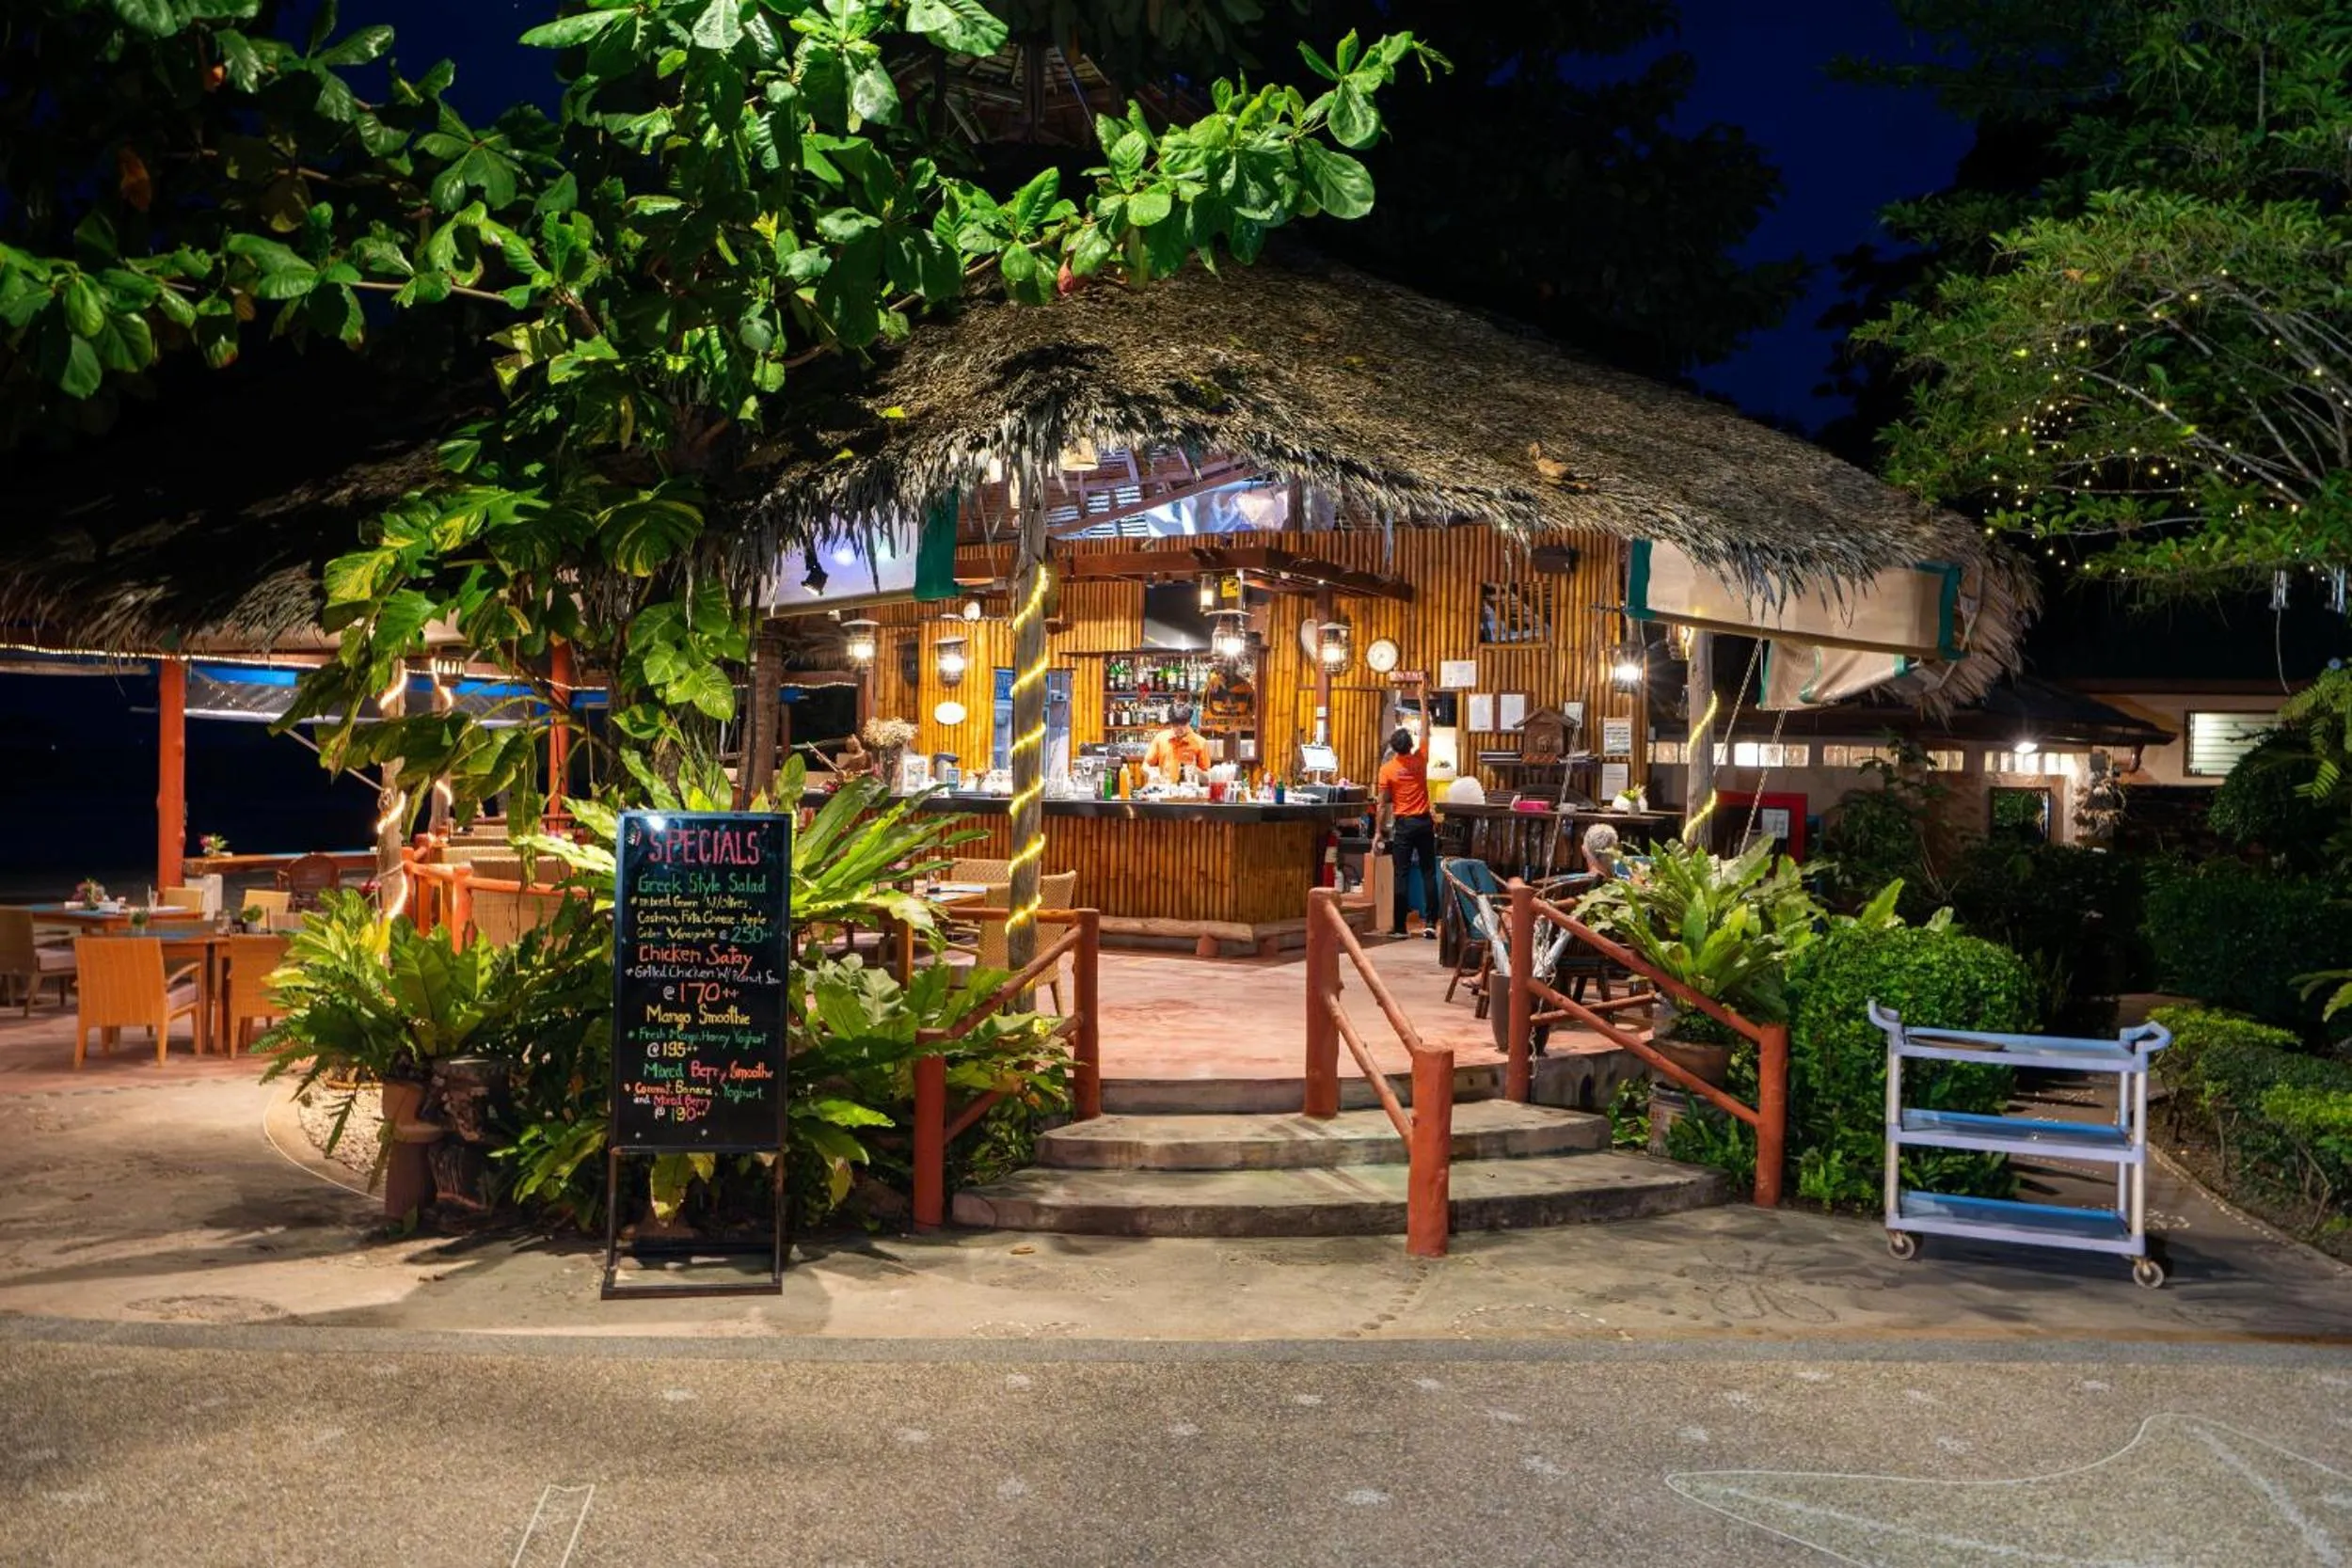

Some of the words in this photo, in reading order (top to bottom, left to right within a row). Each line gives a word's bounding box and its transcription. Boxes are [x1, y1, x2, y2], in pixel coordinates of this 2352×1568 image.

[648, 828, 760, 864] SPECIALS
[638, 873, 682, 893] Greek
[689, 873, 721, 896] Style
[728, 872, 766, 893] Salad
[639, 943, 701, 963] Chicken
[706, 943, 753, 980] Satay
[646, 1004, 691, 1030] Mango
[698, 1004, 751, 1025] Smoothie
[646, 1041, 660, 1057] @
[644, 1062, 685, 1079] Mixed
[690, 1059, 727, 1085] Berry
